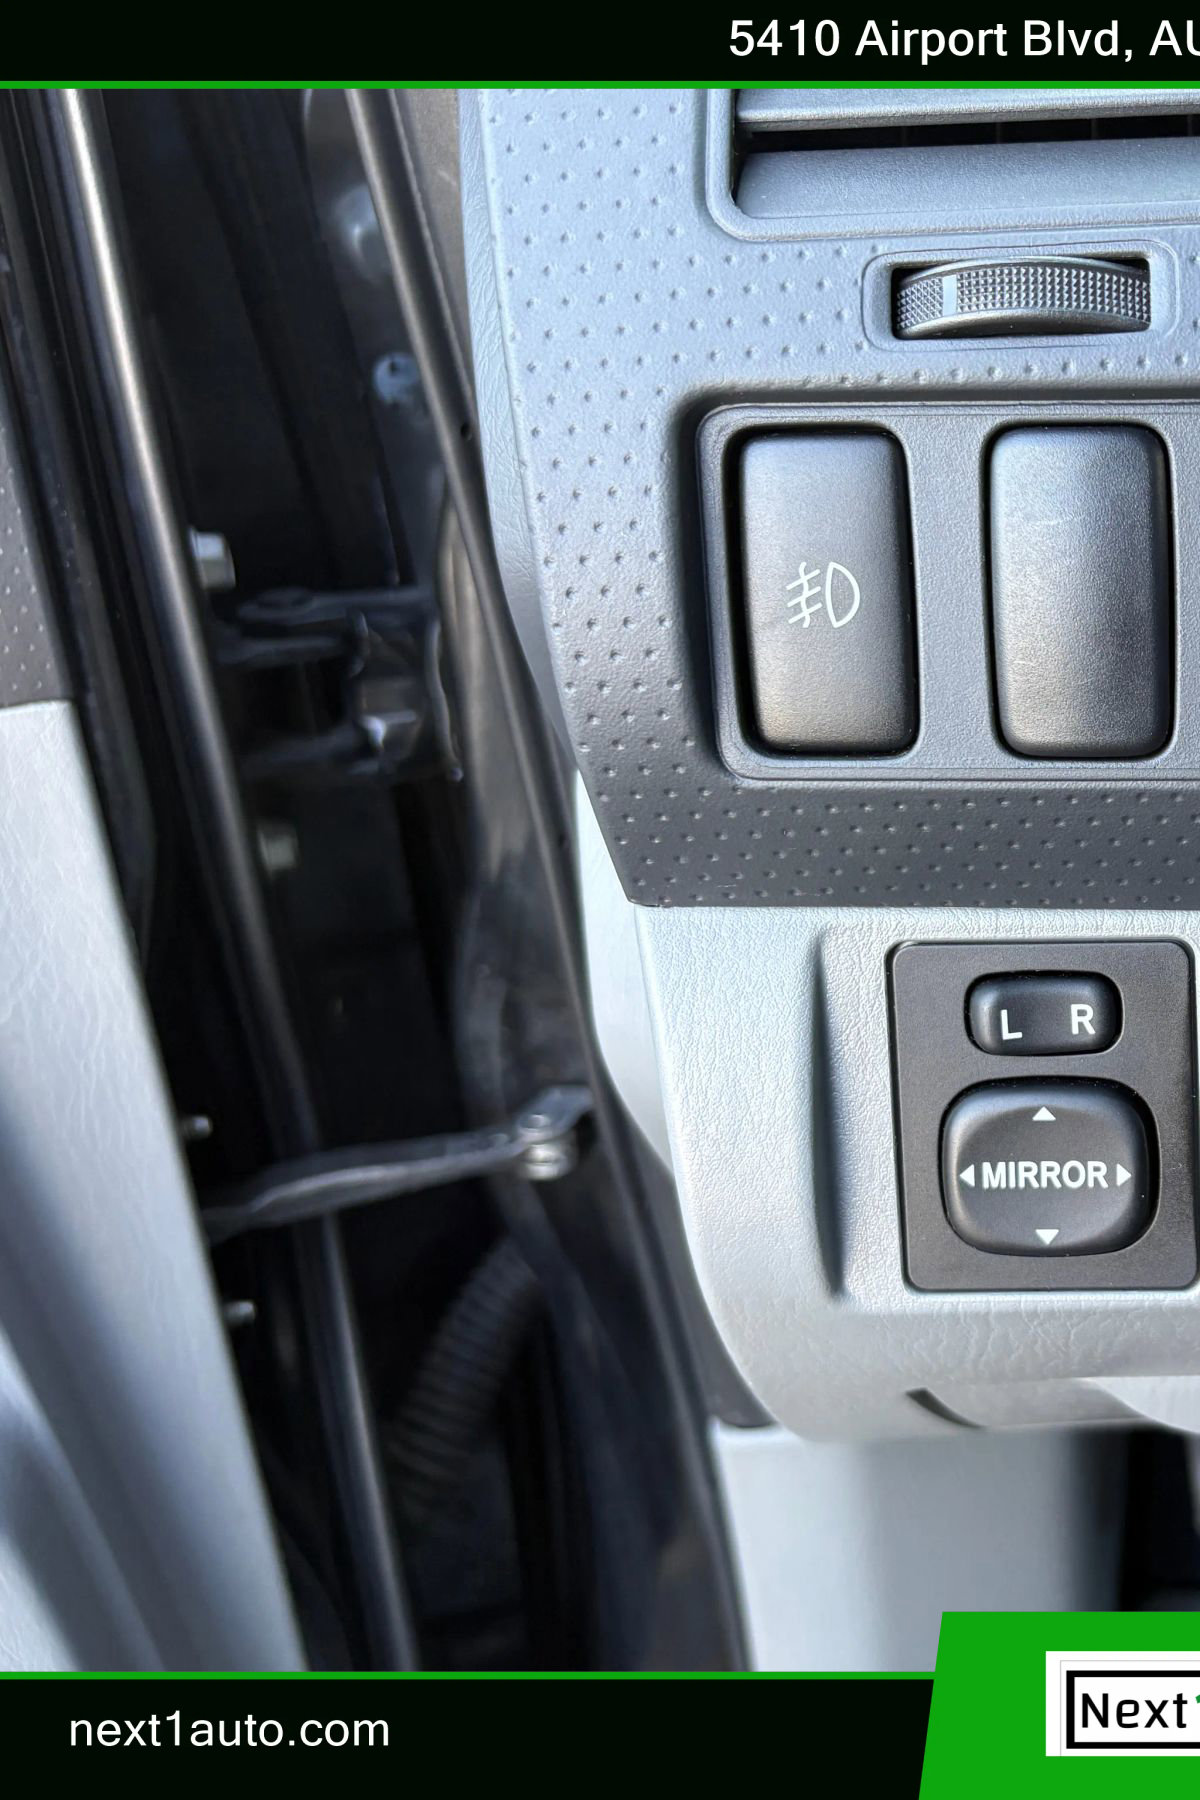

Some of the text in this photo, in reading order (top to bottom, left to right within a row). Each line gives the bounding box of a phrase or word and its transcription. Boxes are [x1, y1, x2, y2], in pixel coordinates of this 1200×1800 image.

[1000, 1003, 1096, 1040] L R
[982, 1160, 1109, 1190] MIRROR
